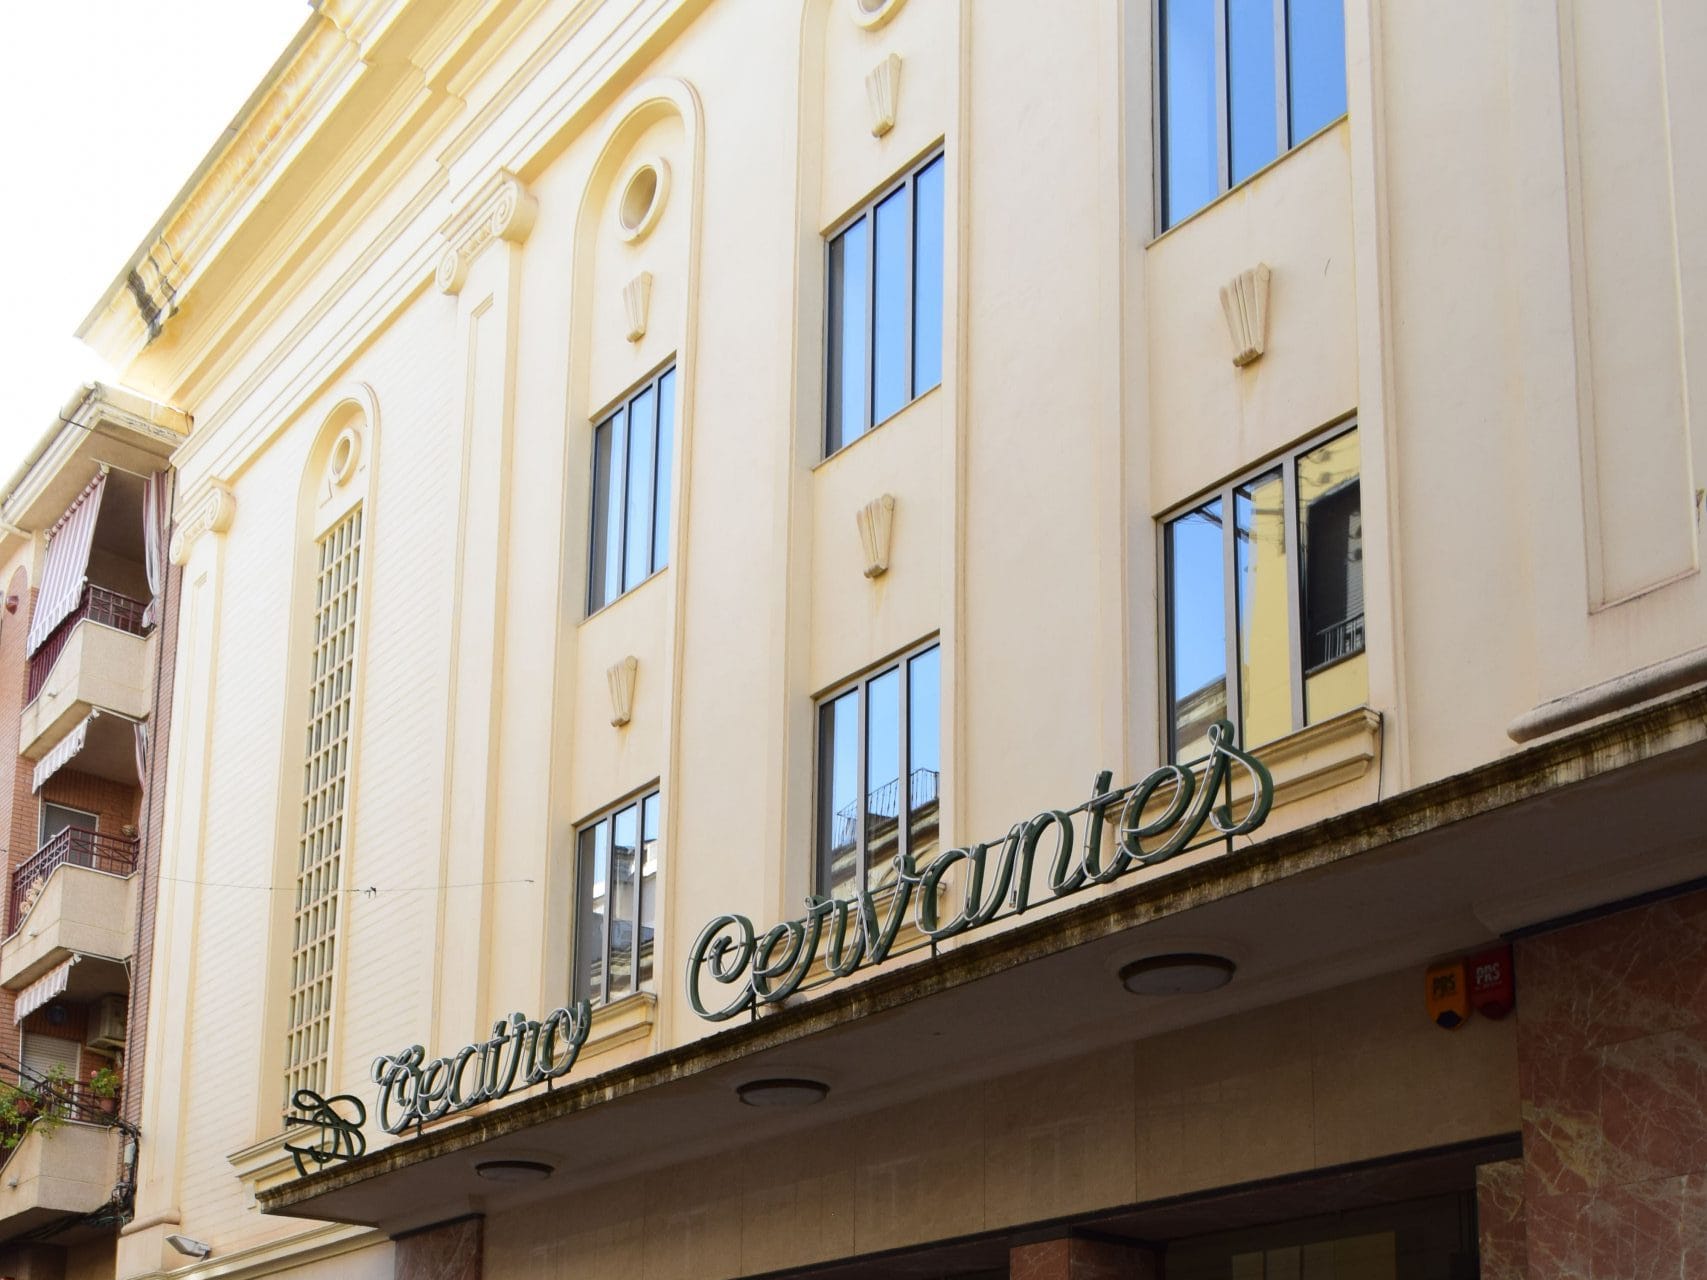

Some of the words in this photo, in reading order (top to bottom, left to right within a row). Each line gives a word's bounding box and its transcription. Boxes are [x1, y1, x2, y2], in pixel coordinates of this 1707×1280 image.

[371, 998, 592, 1135] Teatro
[685, 720, 1274, 1022] Cervantes
[1475, 962, 1501, 985] PRS
